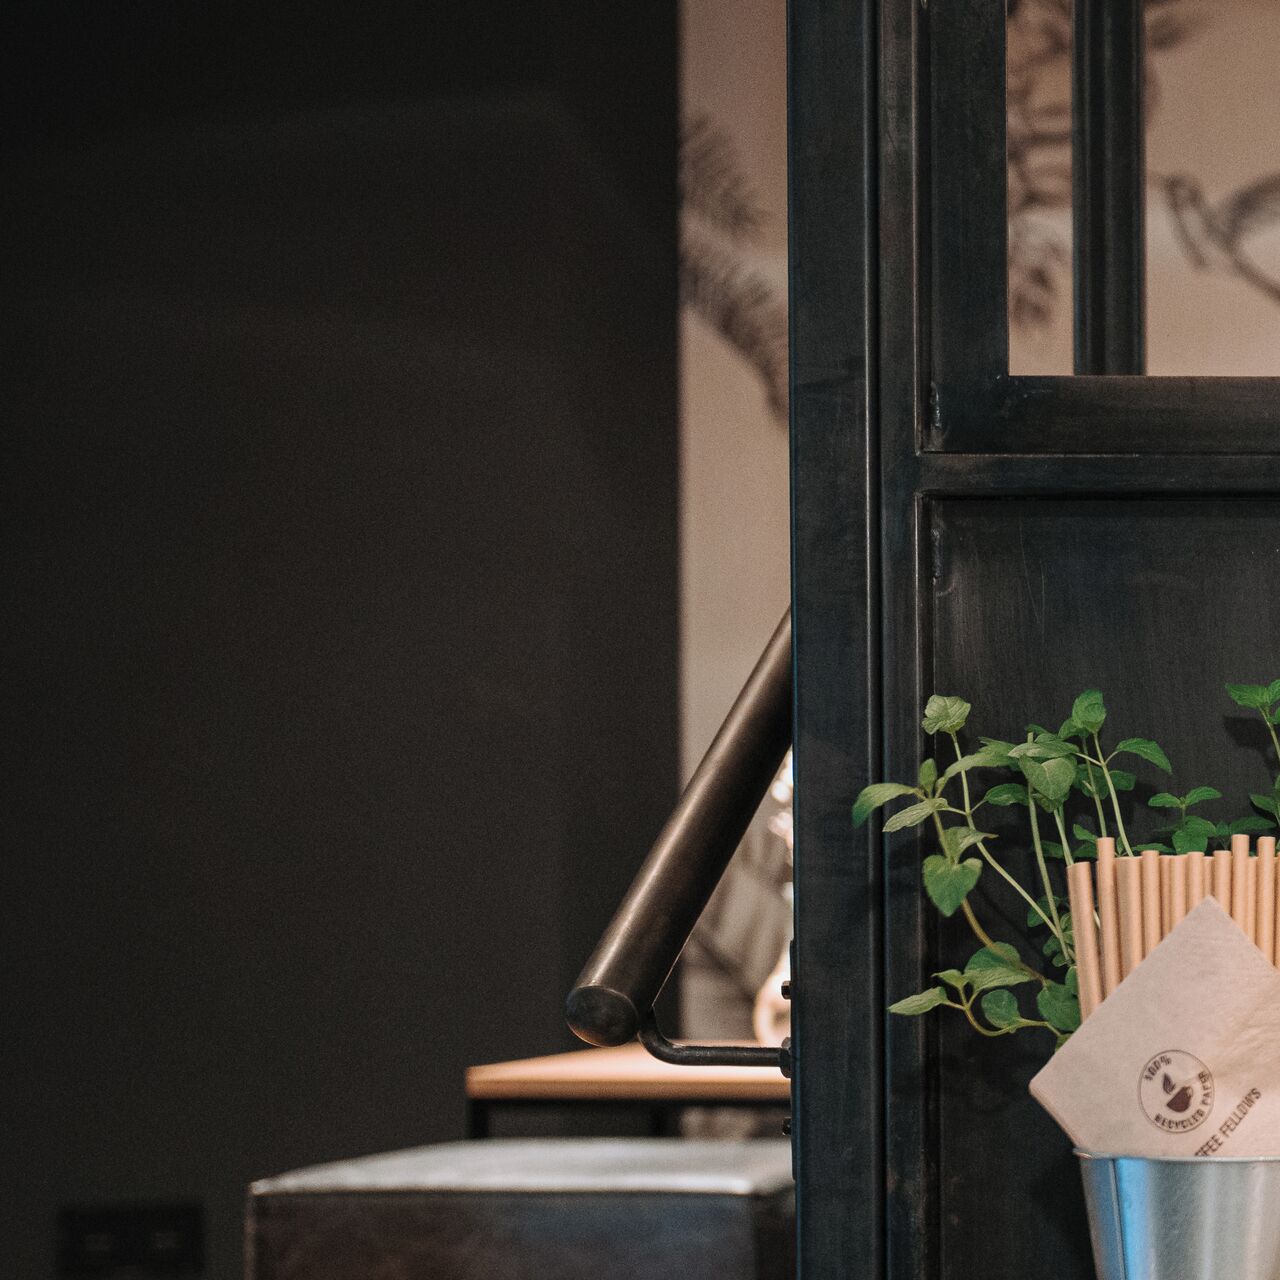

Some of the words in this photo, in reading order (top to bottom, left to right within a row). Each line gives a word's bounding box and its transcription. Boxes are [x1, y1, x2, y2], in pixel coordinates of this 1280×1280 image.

[1144, 1055, 1172, 1081] 100%
[1154, 1108, 1205, 1129] RECYCLED
[1198, 1070, 1212, 1105] PAPER
[1219, 1087, 1261, 1137] FELLOWS
